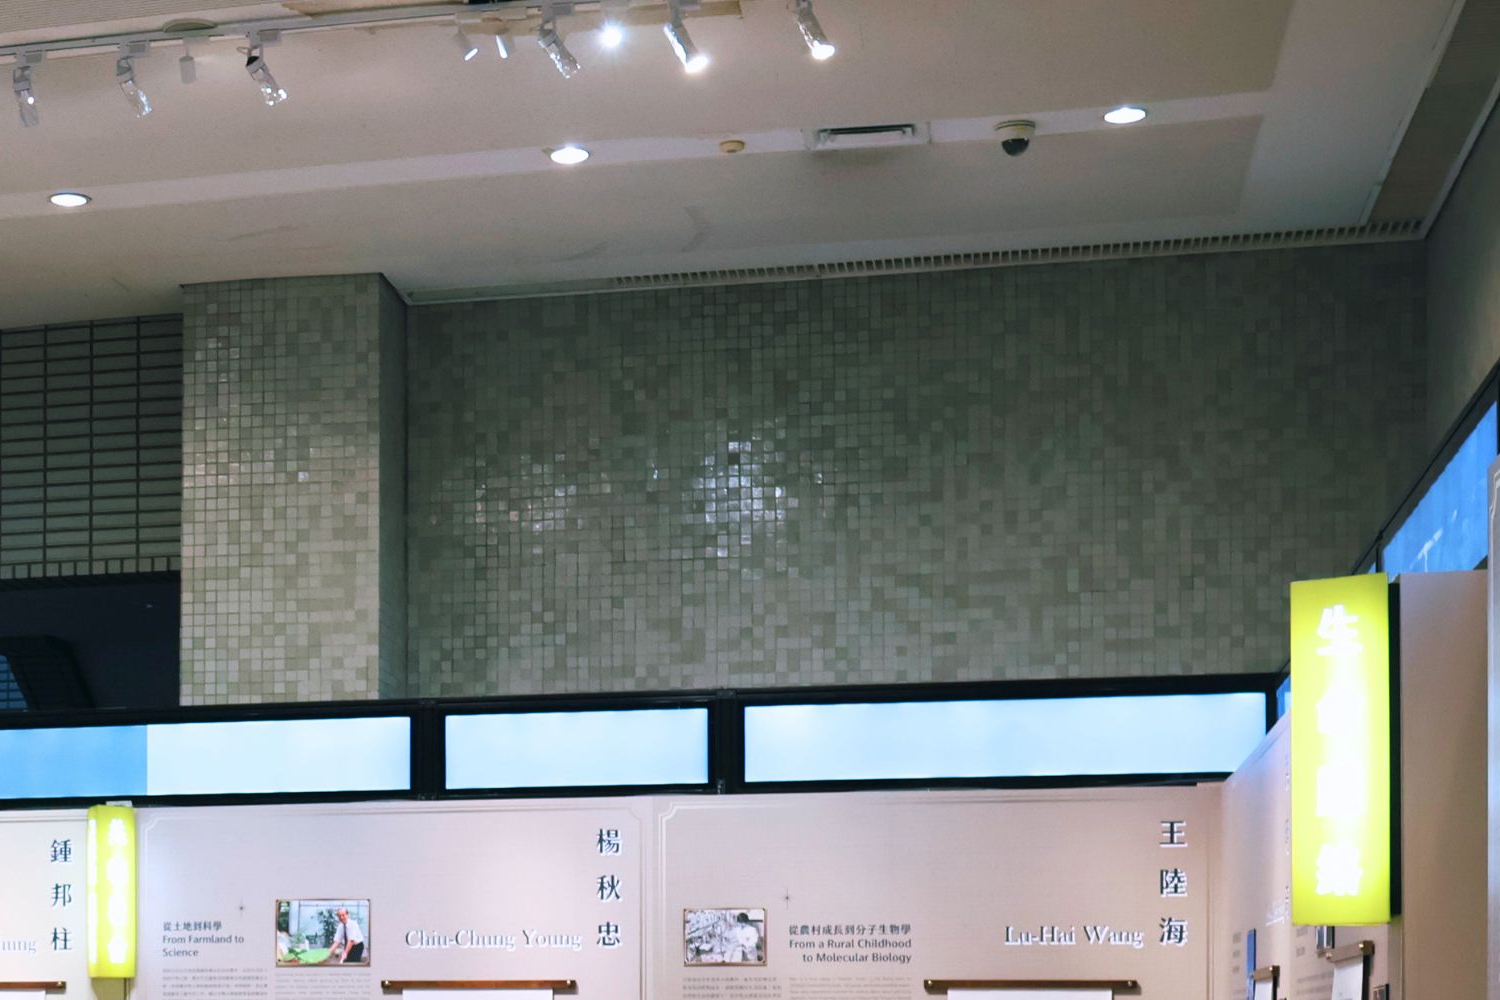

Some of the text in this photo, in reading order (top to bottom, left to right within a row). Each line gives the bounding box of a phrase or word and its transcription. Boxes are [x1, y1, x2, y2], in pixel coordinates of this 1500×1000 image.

[596, 827, 622, 948] 楊秋忠
[1159, 820, 1188, 947] 王陸海
[50, 839, 72, 951] 鍾邦柱
[164, 921, 222, 931] 從土地到科學
[788, 924, 911, 936] 從農村成長到分子生物學
[163, 935, 244, 944] From Farmland to
[405, 929, 582, 951] Chiu-Chung Young
[1004, 925, 1145, 949] Lu-Hai Wang
[789, 939, 911, 949] From a Rural Childhood
[162, 948, 199, 957] Science
[803, 953, 911, 964] to Molecular Biology
